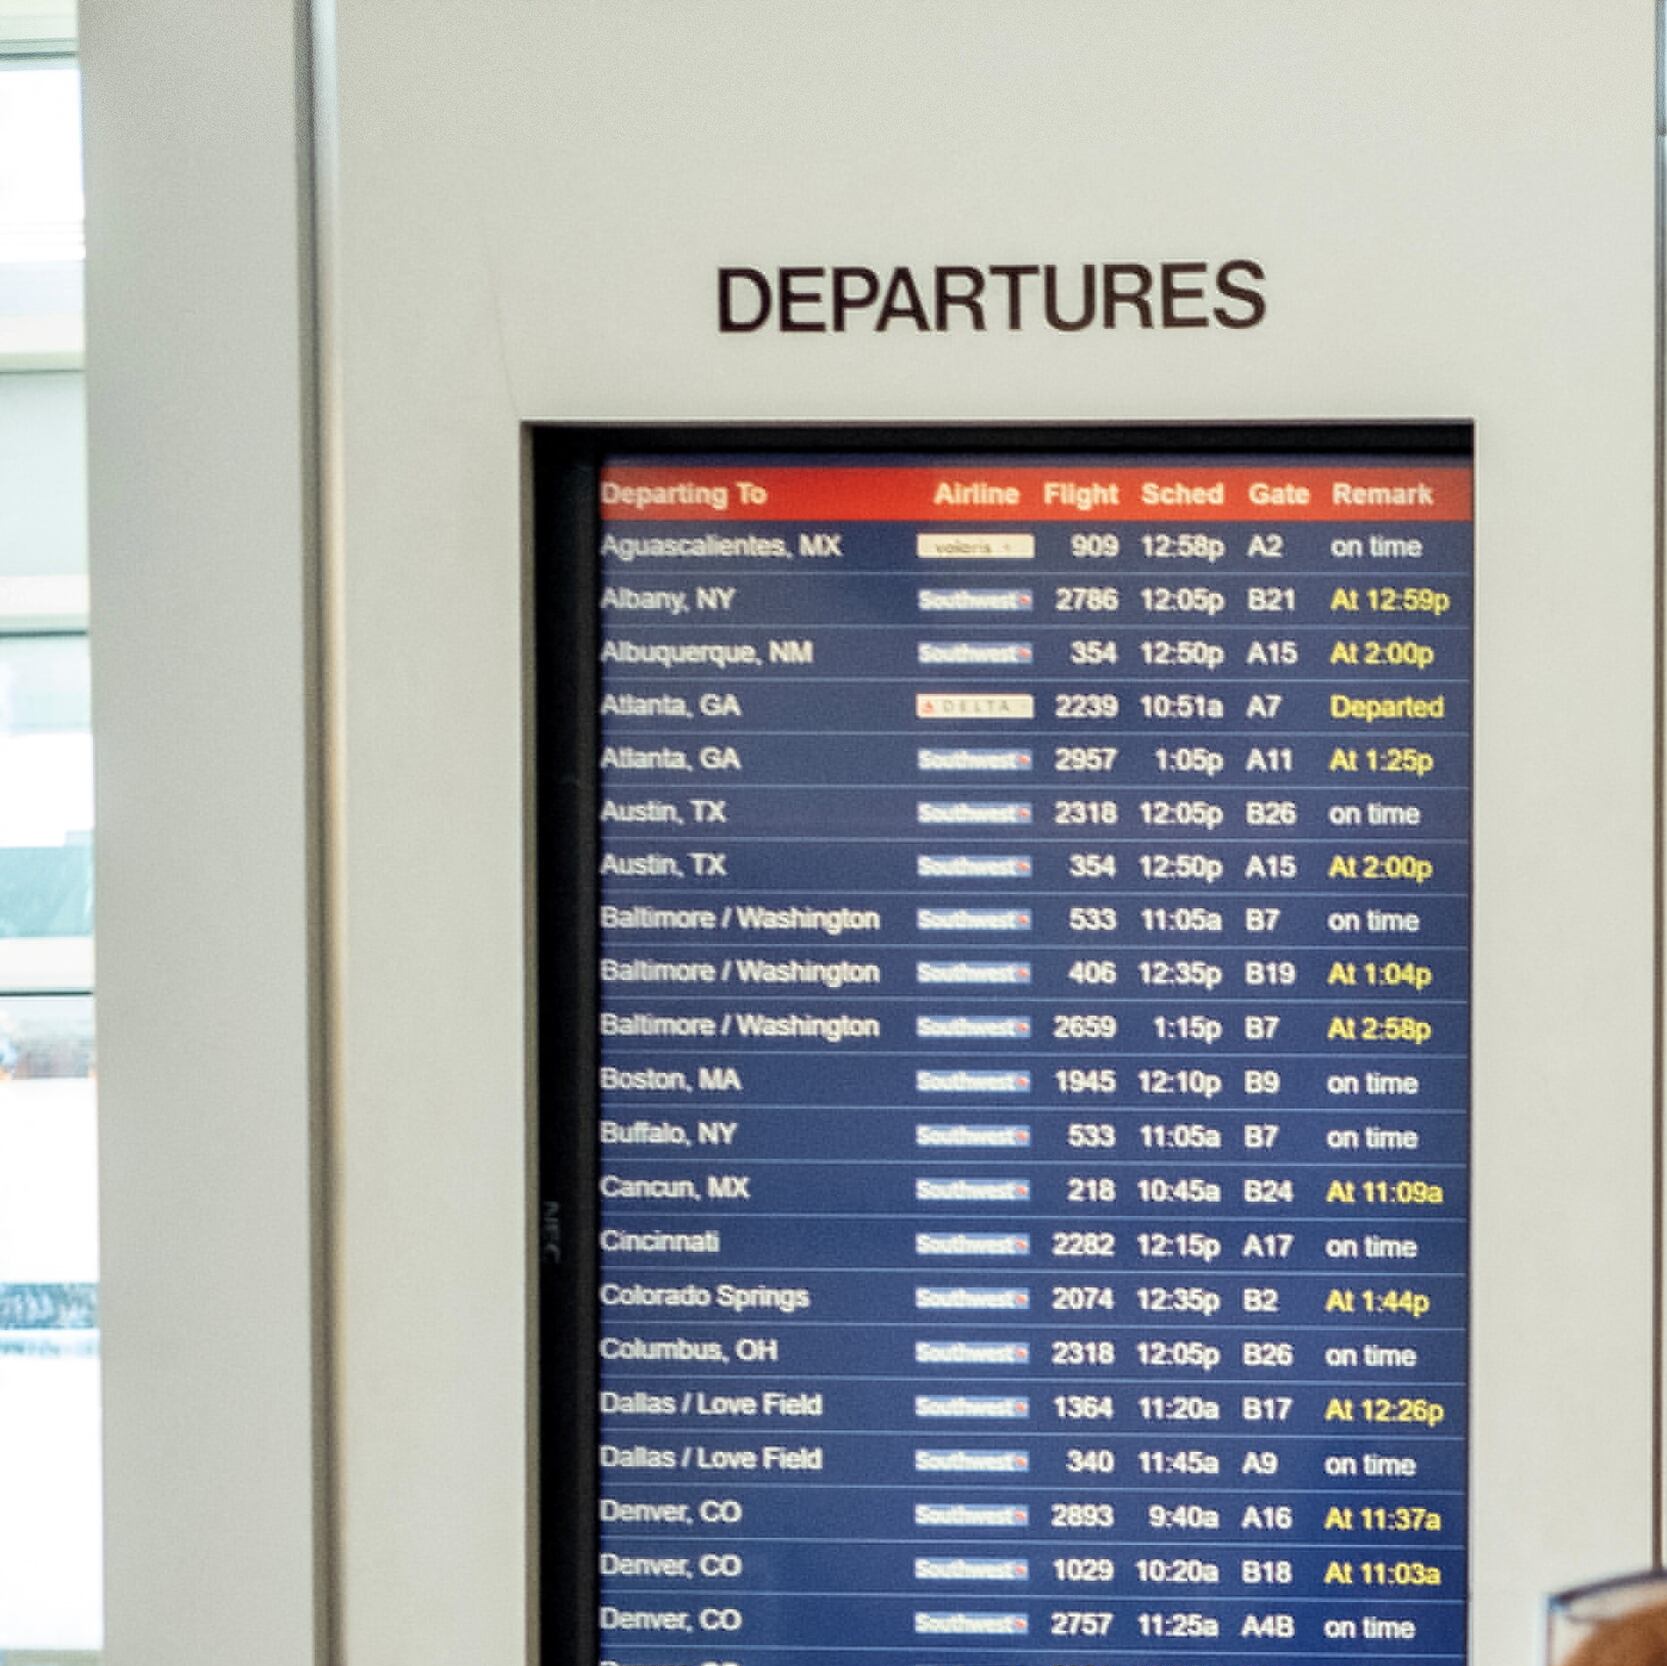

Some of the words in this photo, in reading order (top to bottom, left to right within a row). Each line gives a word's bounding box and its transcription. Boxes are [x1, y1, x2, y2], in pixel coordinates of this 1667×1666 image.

[718, 259, 1266, 333] DEPARTURES
[602, 482, 729, 511] Departing
[736, 481, 768, 505] To
[933, 481, 1022, 506] Airline
[1043, 481, 1121, 512] Flight
[1140, 481, 1226, 507] Sched
[1247, 481, 1312, 506] Gate
[1331, 481, 1435, 506] Remark
[601, 693, 694, 719] Atlanta,
[699, 693, 742, 717] GA
[941, 698, 1010, 714] DELTA
[1055, 693, 1119, 718] 2239
[1140, 694, 1224, 718] 10:51a
[1246, 694, 1283, 718] A7
[1330, 694, 1445, 723] Departed
[600, 1283, 712, 1307] Colorado
[715, 1284, 811, 1314] Springs
[916, 1288, 1008, 1308] Southwest
[1051, 1286, 1115, 1310] 2074
[1136, 1287, 1221, 1317] 12:35p
[1243, 1288, 1279, 1312] B2
[1325, 1289, 1355, 1312] At
[1361, 1289, 1430, 1318] 1:44p
